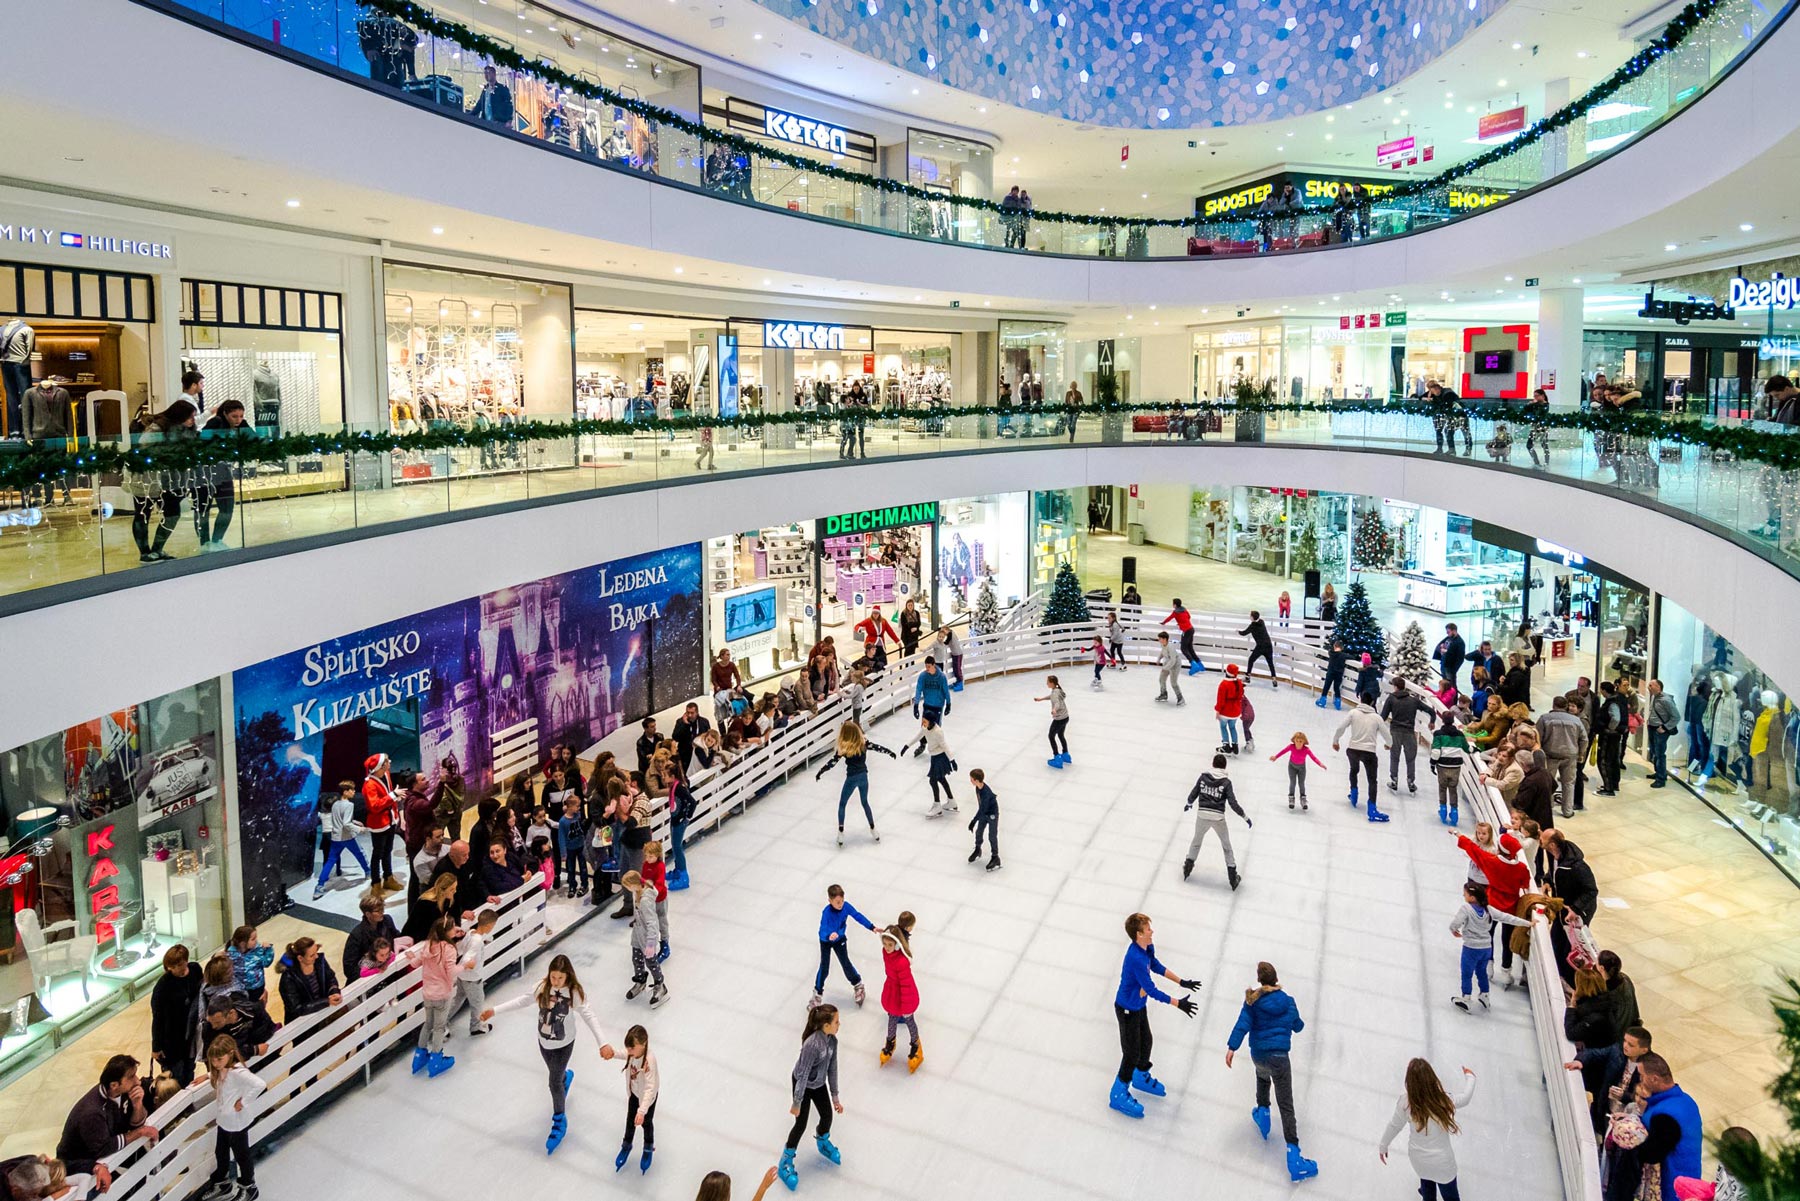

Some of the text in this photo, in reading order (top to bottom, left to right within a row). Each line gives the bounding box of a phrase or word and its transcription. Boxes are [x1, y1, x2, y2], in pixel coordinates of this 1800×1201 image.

[1205, 183, 1273, 216] SHOOSTEP
[88, 235, 172, 259] HILFIGER
[1665, 338, 1690, 346] ZARA
[826, 502, 935, 535] DEICHMANN
[599, 565, 668, 598] LEDENA
[608, 602, 660, 632] BAJKA
[302, 630, 421, 687] SPLITSKO
[292, 668, 432, 741] KLIZALIŠTE
[166, 763, 187, 787] JUST
[162, 795, 198, 817] KARE
[87, 824, 121, 945] KARE
